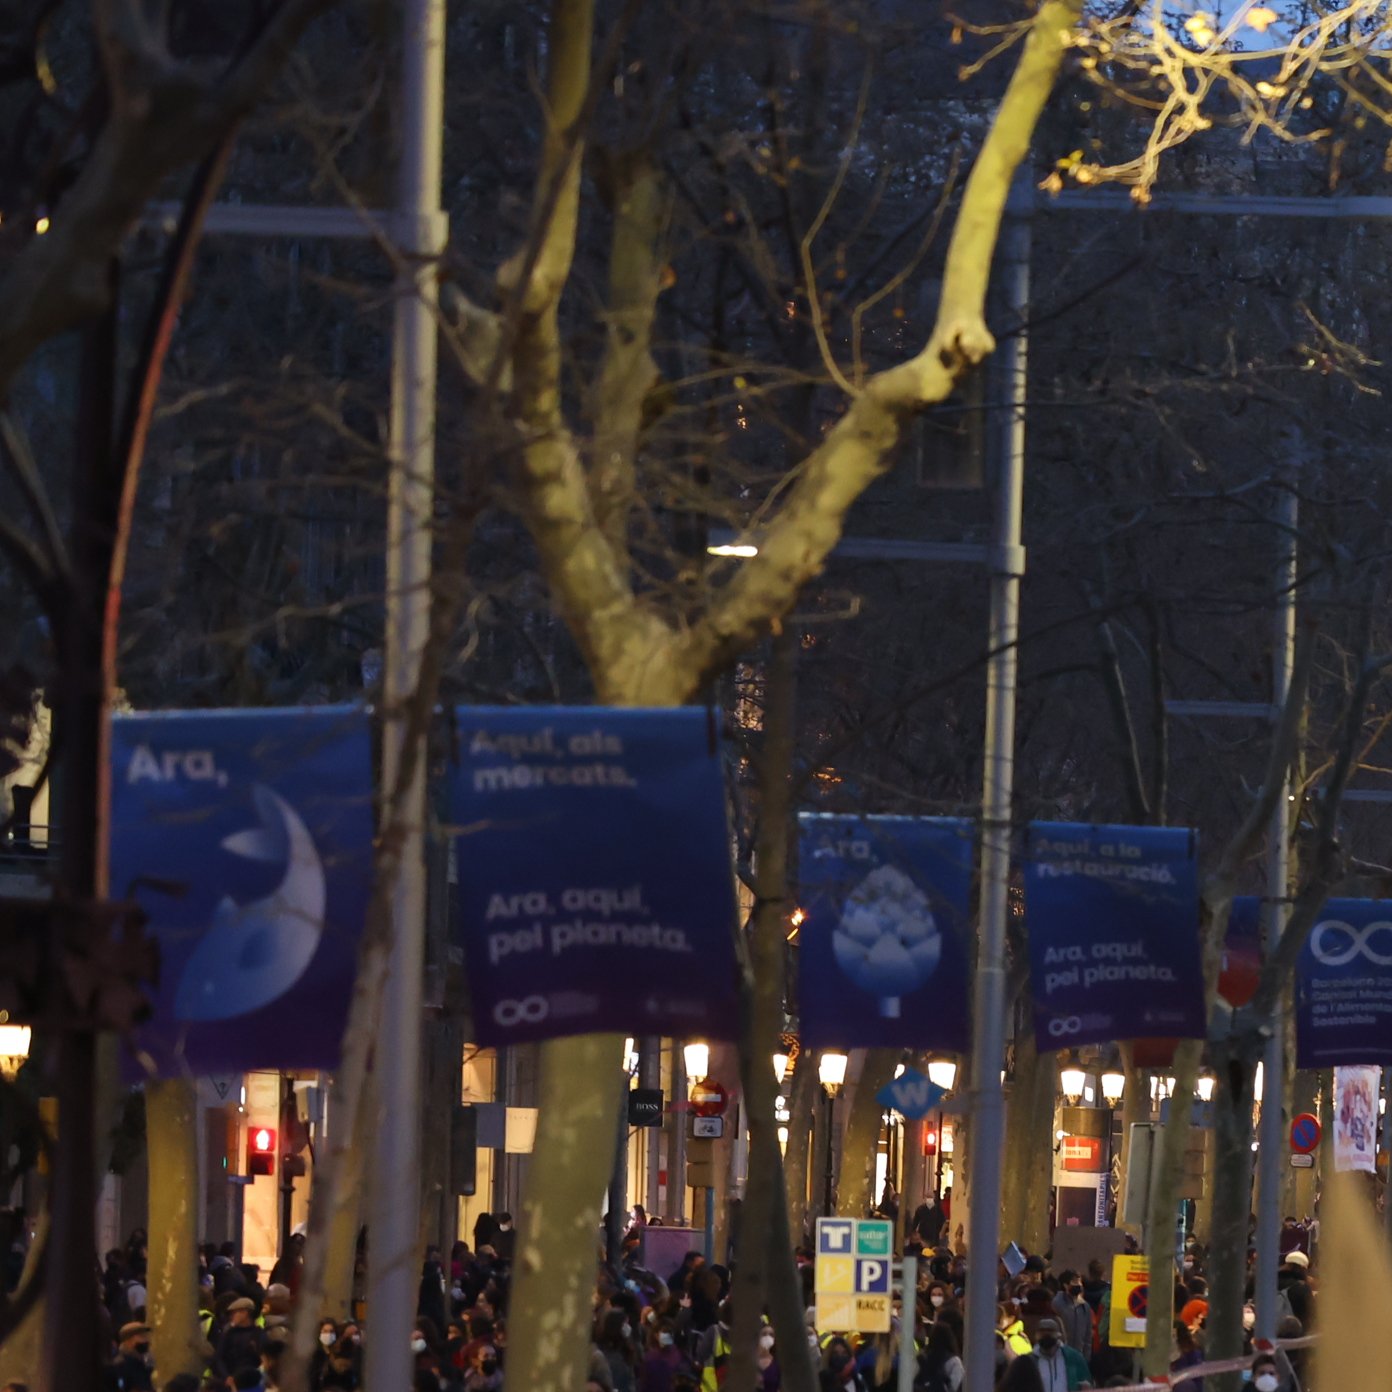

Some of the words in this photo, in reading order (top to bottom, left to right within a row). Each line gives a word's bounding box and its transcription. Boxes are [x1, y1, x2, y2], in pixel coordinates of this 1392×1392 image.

[567, 731, 623, 756] als
[127, 743, 229, 789] Ara,
[473, 763, 639, 792] mercats.
[1036, 861, 1177, 884] restauració.
[485, 892, 556, 922] Ara,
[562, 884, 652, 920] aquí,
[488, 921, 543, 966] pel
[550, 917, 694, 957] planeta.
[1044, 946, 1088, 965] Ara,
[1091, 940, 1149, 962] aquí,
[1044, 964, 1079, 994] pel
[1083, 963, 1178, 988] planeta.
[637, 1103, 659, 1111] BOSS
[861, 1260, 882, 1291] P
